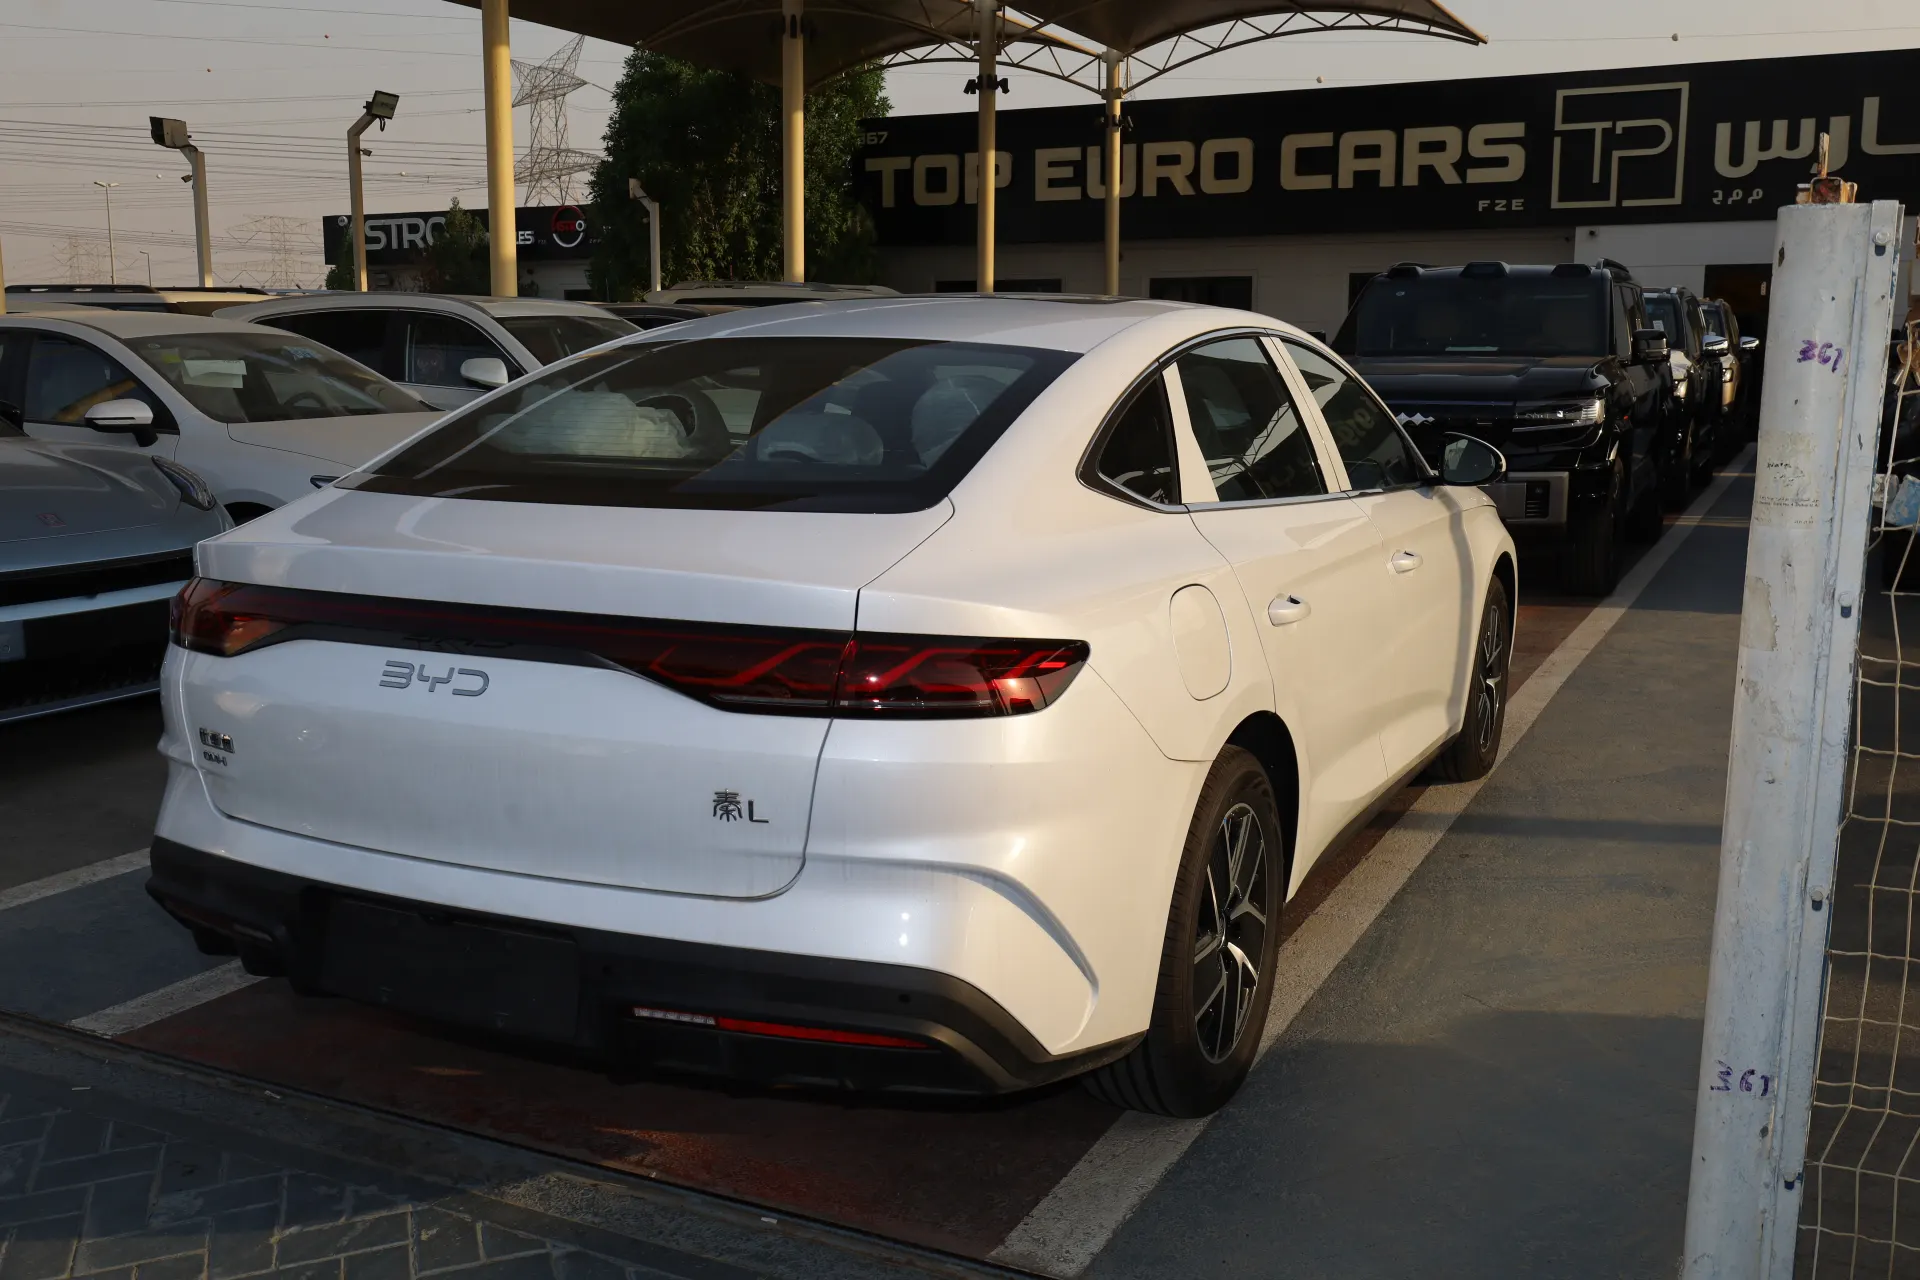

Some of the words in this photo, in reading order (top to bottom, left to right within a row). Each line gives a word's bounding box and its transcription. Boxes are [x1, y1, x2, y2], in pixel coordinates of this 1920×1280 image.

[864, 151, 1010, 208] TOP
[1035, 137, 1254, 202] EURO
[1279, 121, 1526, 191] CARS
[1478, 198, 1525, 212] FZE
[379, 659, 490, 697] BYD
